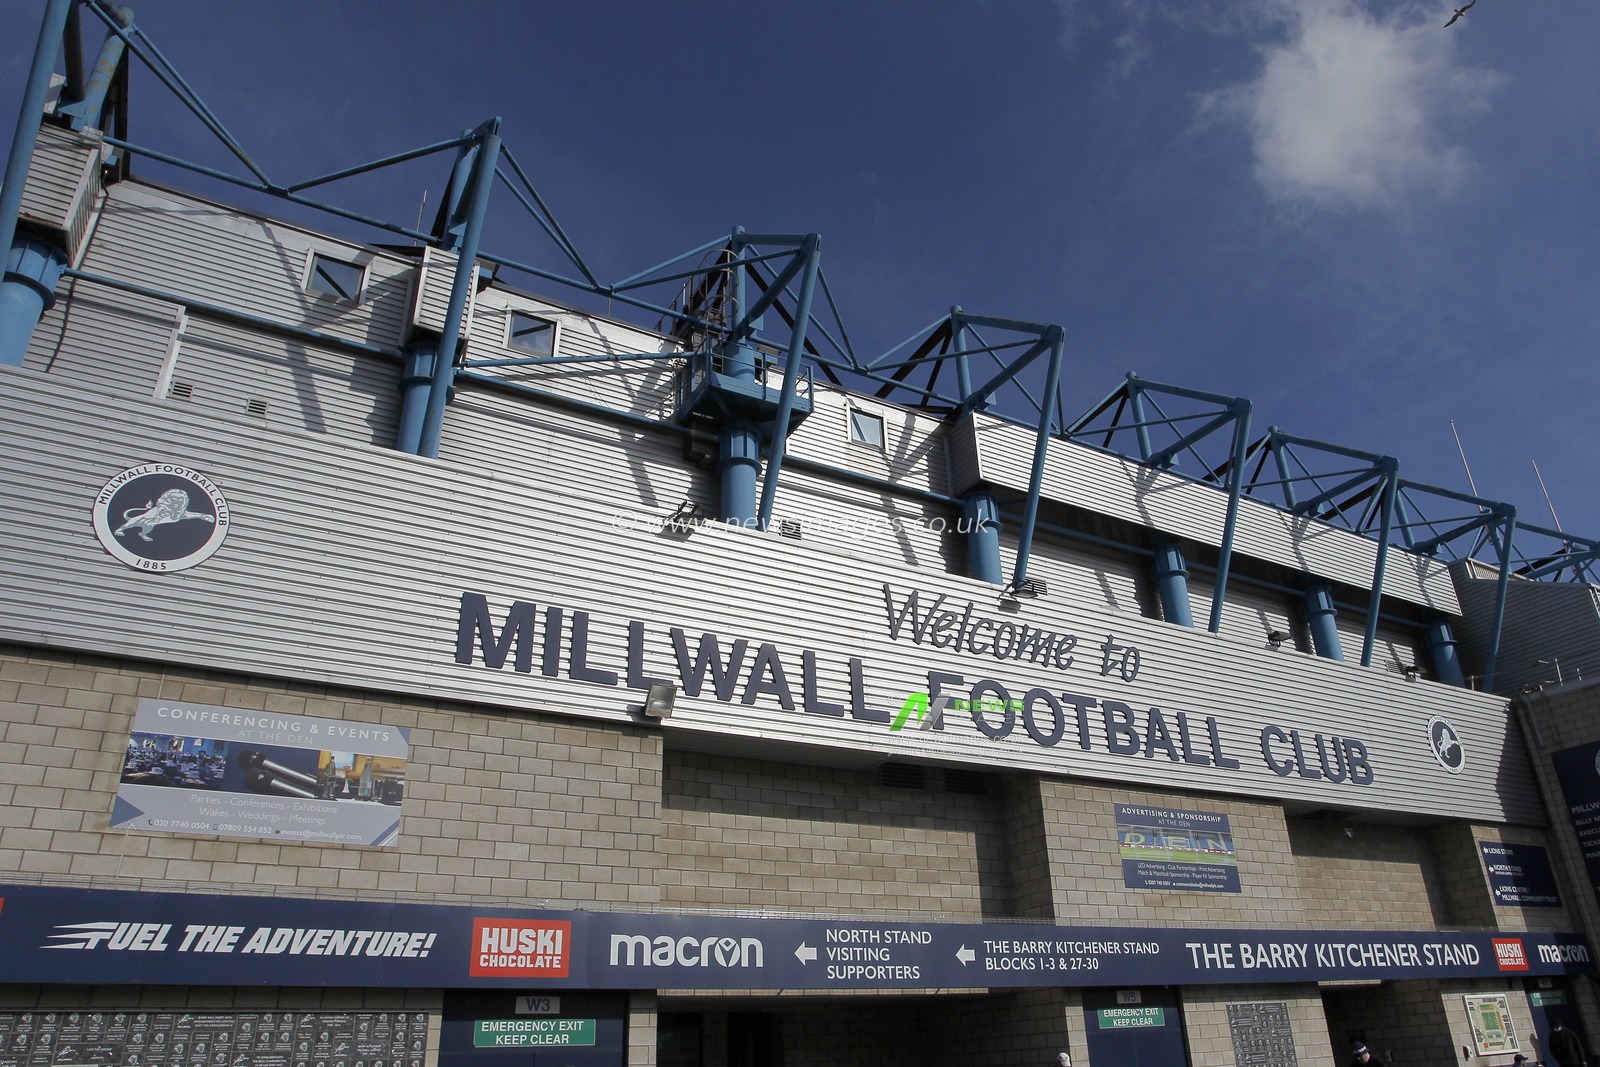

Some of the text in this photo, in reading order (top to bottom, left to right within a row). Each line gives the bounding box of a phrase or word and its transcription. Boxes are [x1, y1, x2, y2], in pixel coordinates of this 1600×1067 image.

[98, 465, 227, 526] MILLWALL FOOTBALL CLUB
[135, 559, 167, 570] 1885
[883, 583, 1141, 682] Welcome to
[455, 591, 1374, 785] MILLWALL FOOTBALL CLUB
[157, 707, 391, 742] CONFERENCING & EVENTS
[237, 729, 314, 745] AT THE DEN
[191, 794, 221, 805] Parties
[230, 797, 285, 811] Conferences
[293, 803, 338, 814] Exhibitions
[200, 807, 229, 818] Wakes
[237, 810, 281, 823] Weddings
[289, 814, 327, 826] Meetings
[1122, 807, 1168, 818] ADVERTISING
[1177, 813, 1221, 823] SPONSORSHIP
[154, 819, 169, 827] 020
[171, 820, 189, 829] 7740
[219, 824, 242, 832] 07809
[259, 826, 272, 834] 852
[39, 921, 438, 959] FUEL THE ADVENTURE!
[480, 927, 563, 954] HUSKI
[826, 928, 932, 945] NORTH STAND
[609, 934, 764, 968] macron
[825, 947, 890, 961] VISITING
[983, 940, 1160, 955] THE BARRY KITCHENER STAND
[1495, 943, 1523, 958] HUSKI
[1537, 944, 1589, 963] macron
[479, 954, 562, 968] CHOCOLATE
[1185, 942, 1480, 969] THE BARRY KITCHENER STAND
[985, 957, 1099, 971] BLOCKS 1-3 & 27-30
[827, 965, 920, 979] SUPPORTERS
[526, 998, 551, 1012] W3
[1103, 1007, 1159, 1017] EMERGENCY EXIT
[481, 1020, 584, 1032] EMERGENCY EXIT
[1112, 1017, 1154, 1027] KEEP CLEAR
[495, 1034, 569, 1045] KEEP CLEAR
